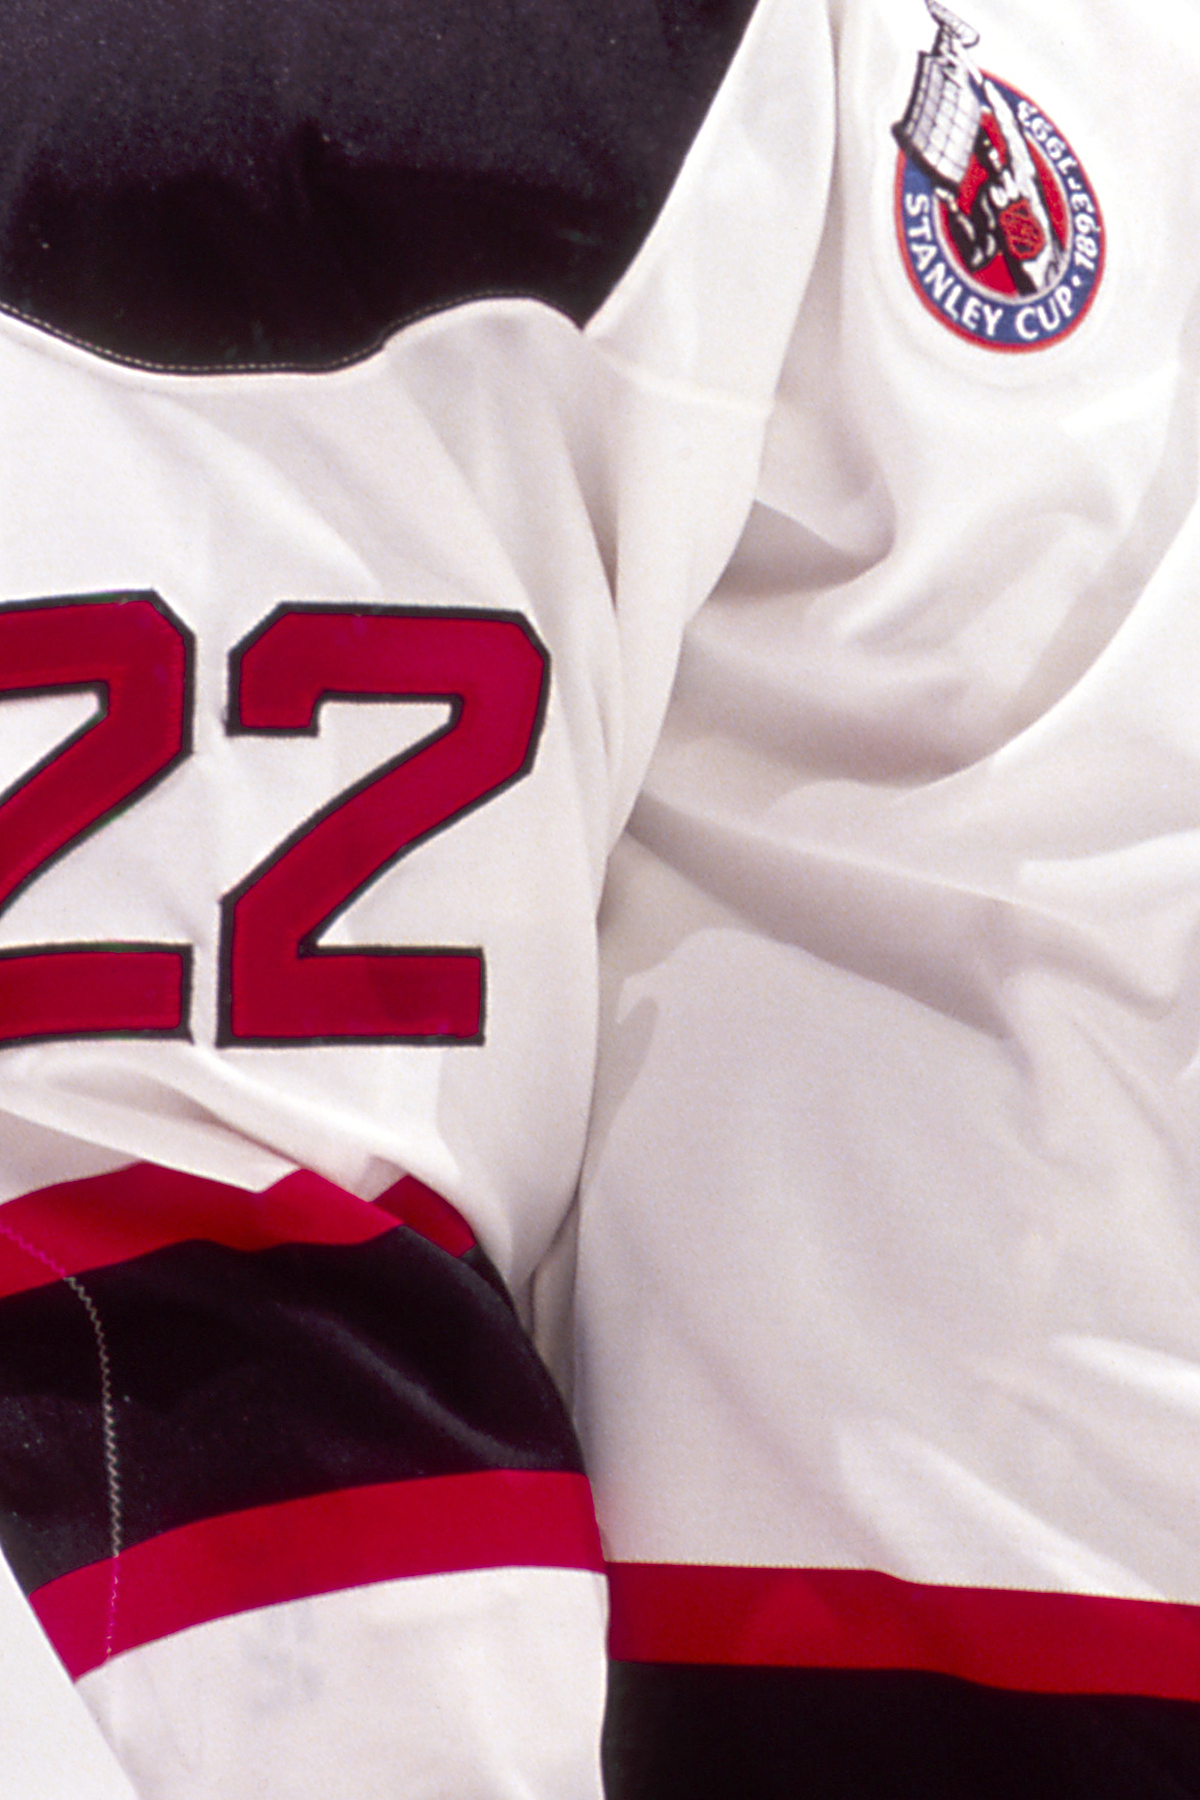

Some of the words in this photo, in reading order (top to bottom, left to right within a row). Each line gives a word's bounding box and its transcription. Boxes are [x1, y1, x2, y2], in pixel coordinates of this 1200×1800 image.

[905, 193, 1003, 336] STANLEY
[1018, 101, 1101, 273] 1893-1993
[1015, 286, 1072, 339] CUP
[0, 588, 551, 1048] 22
